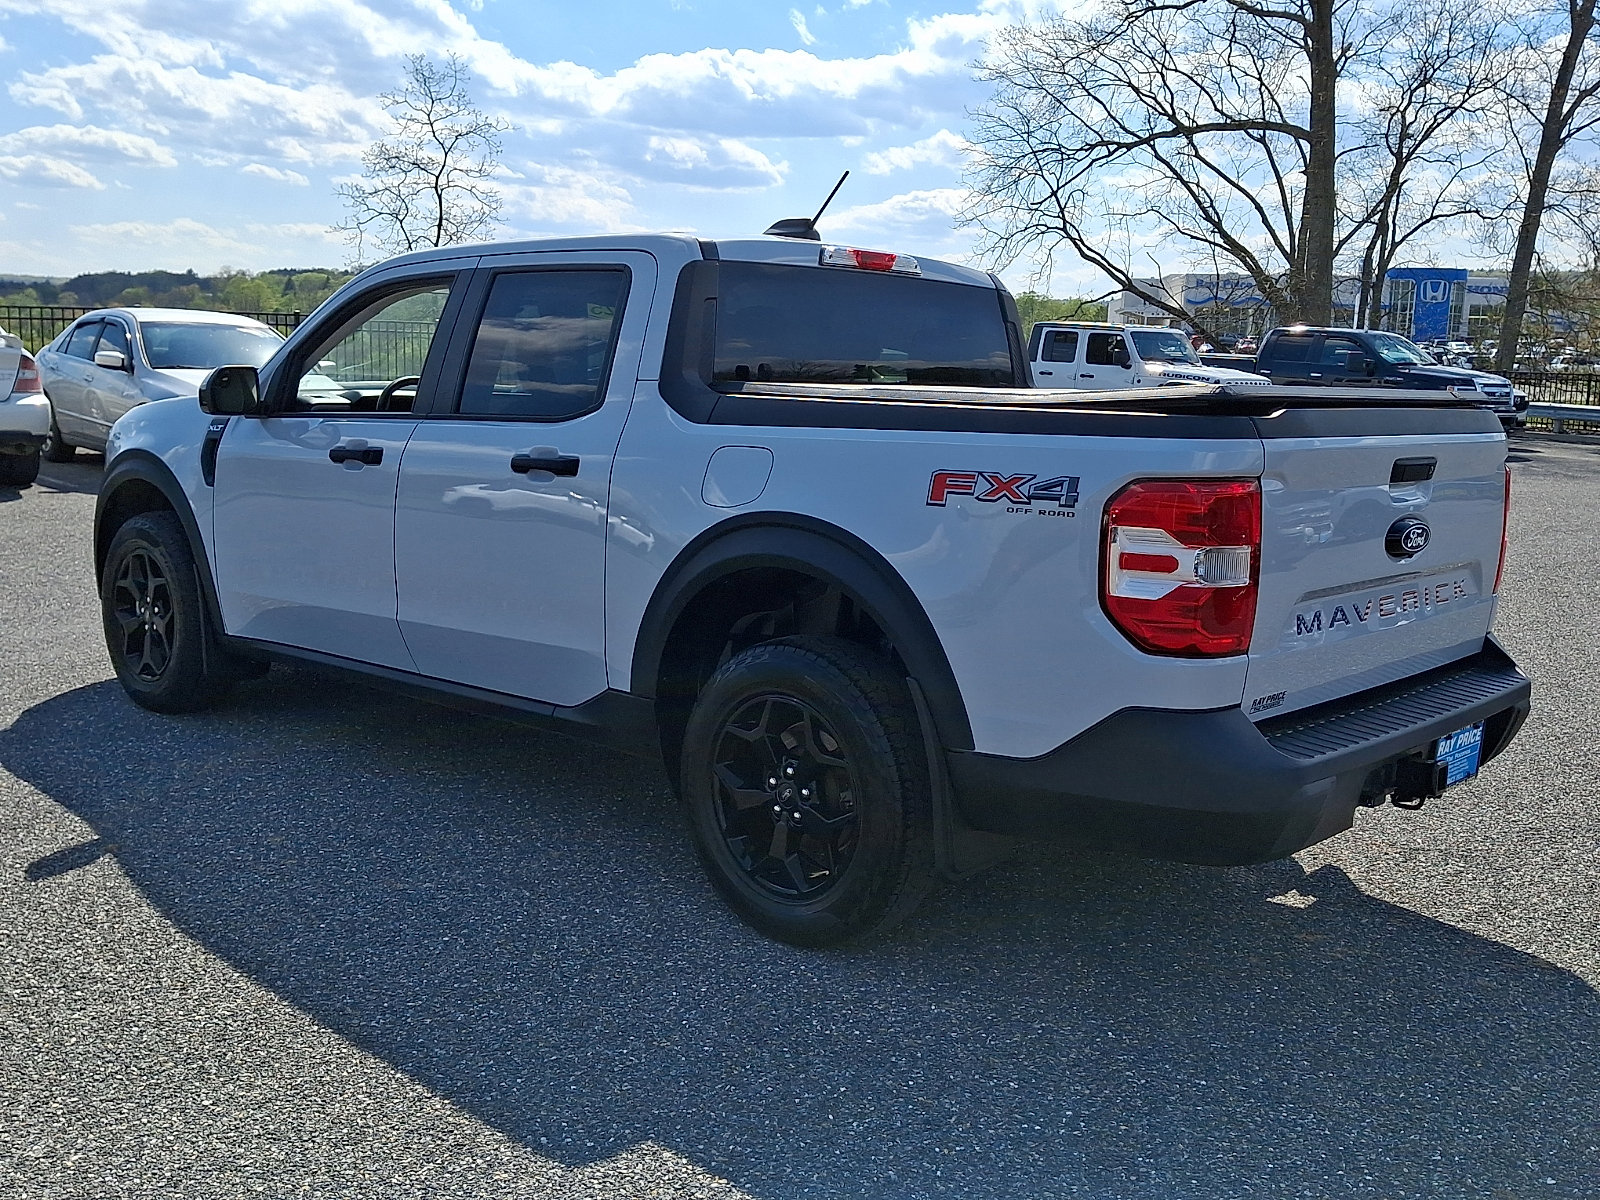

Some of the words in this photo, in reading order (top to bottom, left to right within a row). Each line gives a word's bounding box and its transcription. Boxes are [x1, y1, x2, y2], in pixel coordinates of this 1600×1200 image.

[1159, 372, 1210, 382] RUBICON
[926, 469, 1080, 508] FX4
[1006, 506, 1033, 515] OFF
[1038, 509, 1076, 518] ROAD
[1296, 579, 1468, 637] MAVERICK
[1251, 696, 1267, 707] RAY
[1265, 691, 1287, 704] PRICE
[1437, 736, 1457, 757] RAY
[1456, 726, 1483, 749] PRICE
